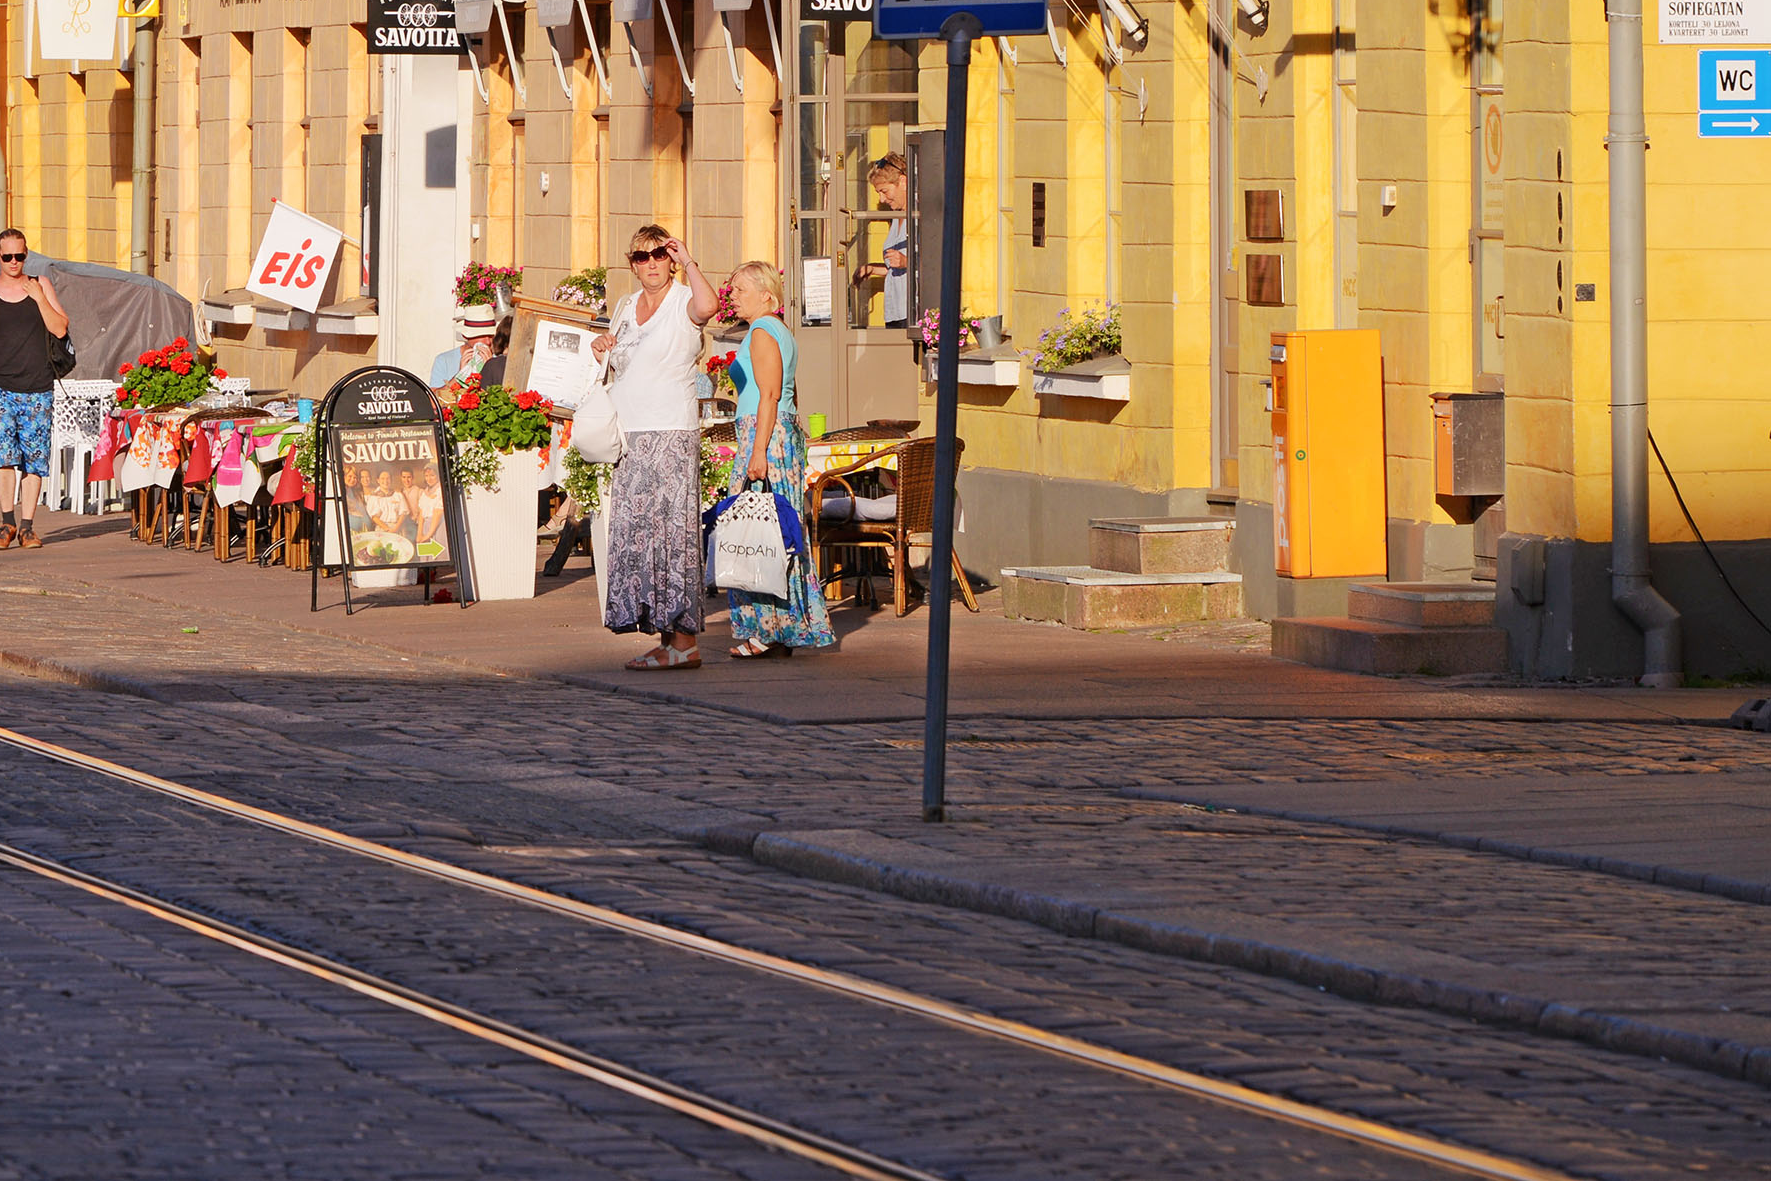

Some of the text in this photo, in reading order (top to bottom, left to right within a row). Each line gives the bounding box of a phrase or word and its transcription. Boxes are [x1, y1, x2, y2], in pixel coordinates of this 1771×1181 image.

[1668, 2, 1744, 16] SOFIEGATAN
[375, 27, 460, 47] SAVOTTA
[1719, 70, 1753, 92] WC
[358, 400, 414, 415] SAVOTTA
[343, 440, 434, 464] SAVOTTA
[718, 540, 777, 559] KappAhl
